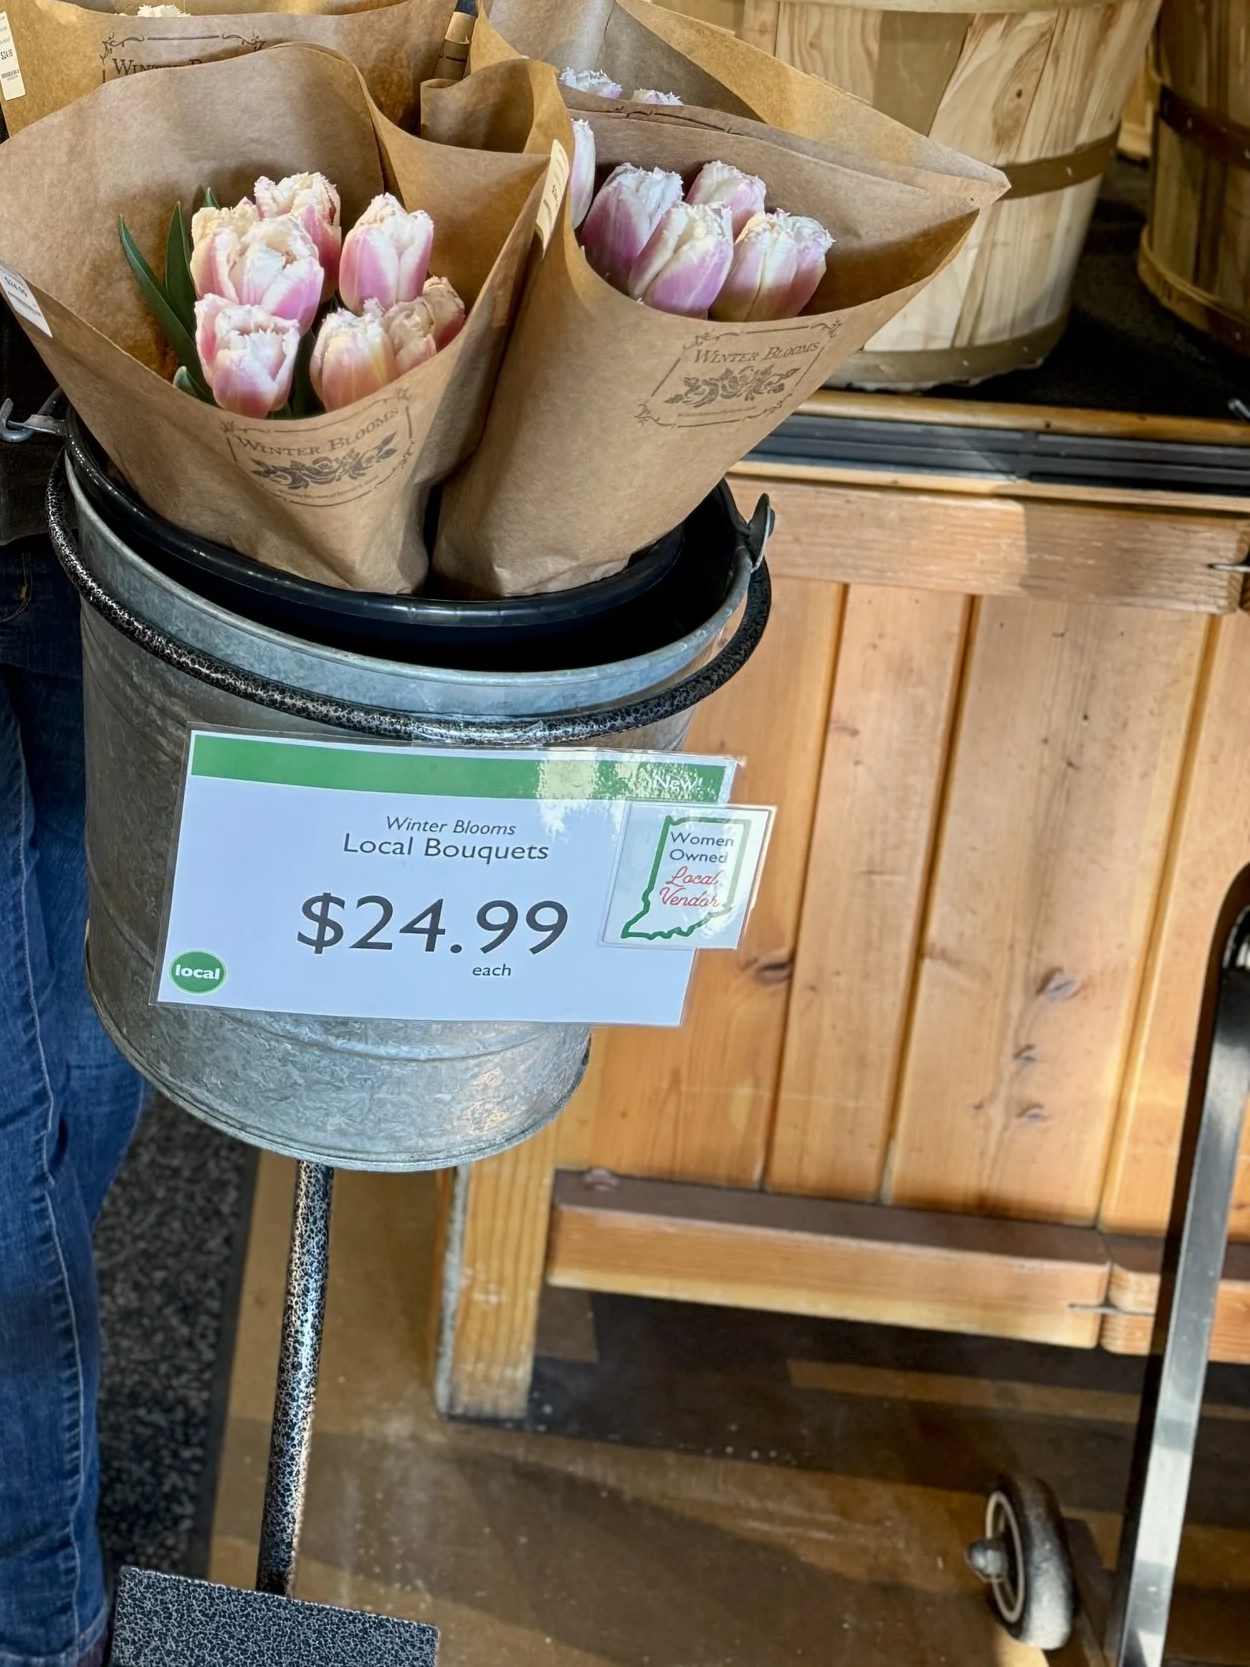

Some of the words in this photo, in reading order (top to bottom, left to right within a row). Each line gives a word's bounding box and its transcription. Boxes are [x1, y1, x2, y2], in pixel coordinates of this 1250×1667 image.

[694, 348, 760, 365] WINTER
[762, 340, 822, 361] BLOOMS
[234, 435, 320, 457] WINTER
[329, 407, 400, 451] BLOOMS
[386, 815, 448, 834] Winter
[453, 819, 516, 836] Blooms
[343, 832, 414, 856] Local
[423, 837, 550, 865] Bouquets
[670, 831, 734, 847] Women
[669, 848, 729, 864] Owned
[665, 866, 722, 887] Local
[659, 885, 721, 908] Vendor
[297, 892, 569, 955] $24.99
[175, 964, 221, 980] local
[472, 963, 512, 977] each
